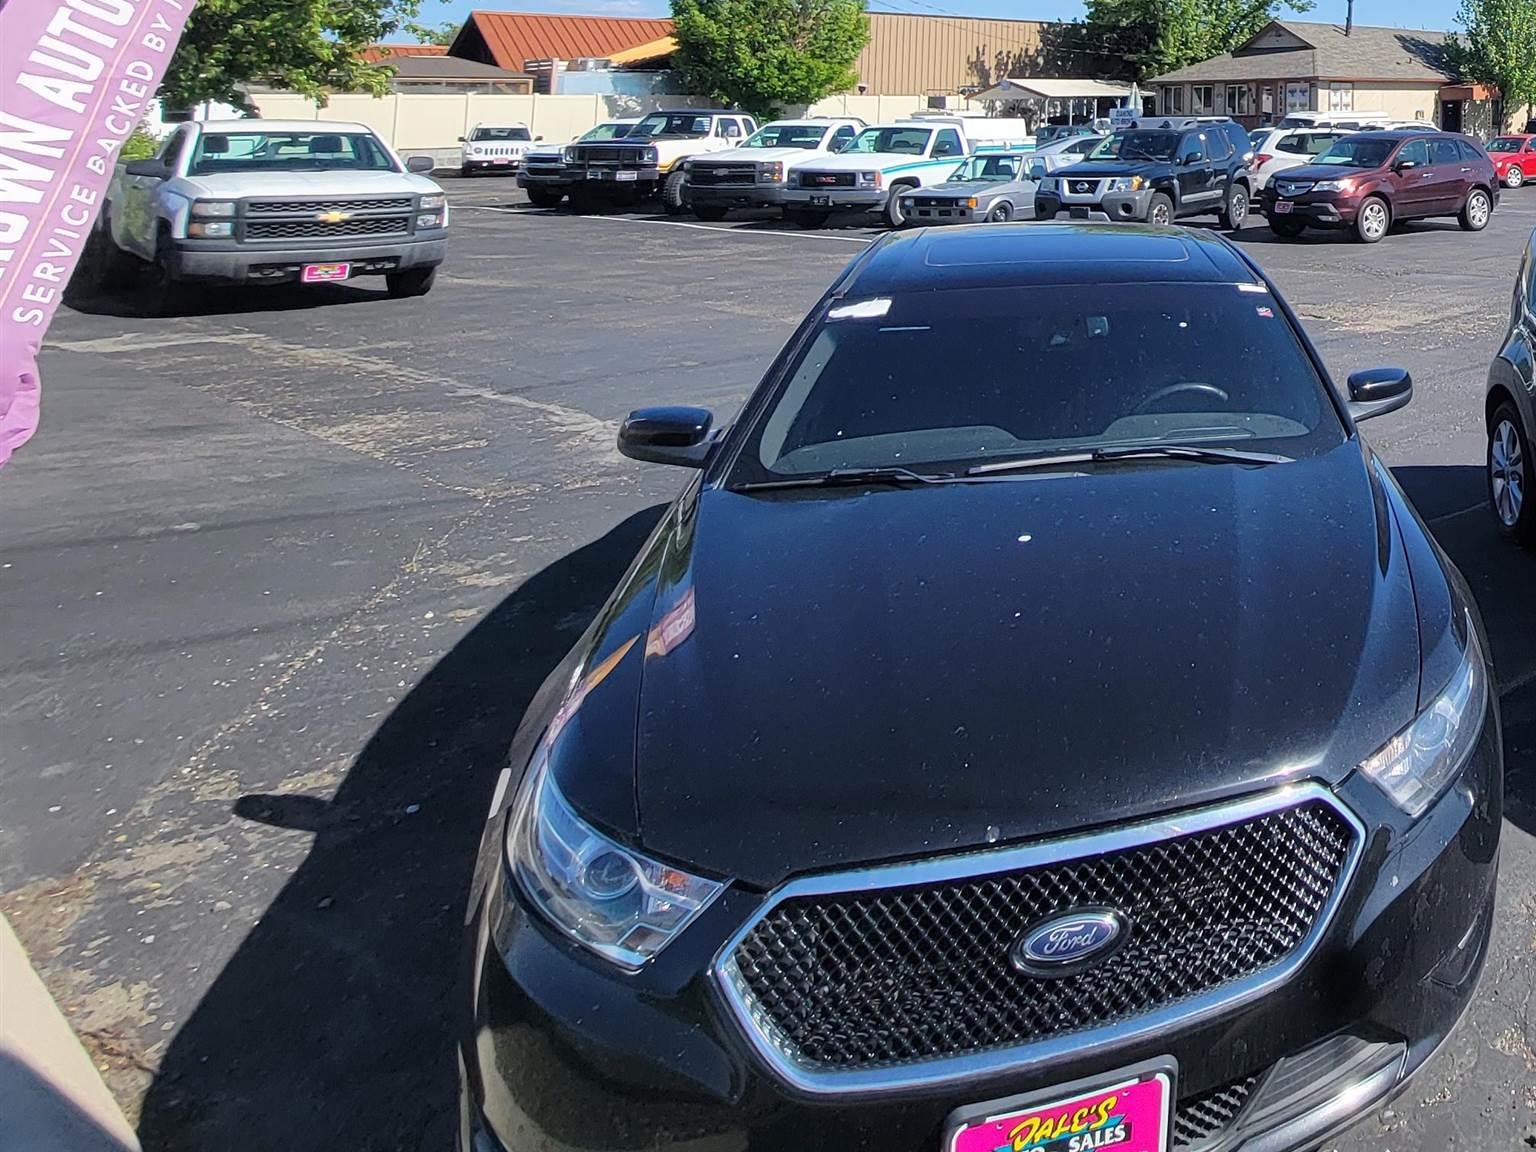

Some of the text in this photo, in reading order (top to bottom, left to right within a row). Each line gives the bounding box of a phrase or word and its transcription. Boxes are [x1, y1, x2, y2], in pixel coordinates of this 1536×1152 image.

[12, 184, 97, 326] SERVICE
[86, 60, 154, 175] BACKED
[142, 12, 172, 52] BY
[1043, 924, 1098, 954] Ford
[1009, 1095, 1118, 1151] DALE'S
[1068, 1124, 1126, 1152] SALES
